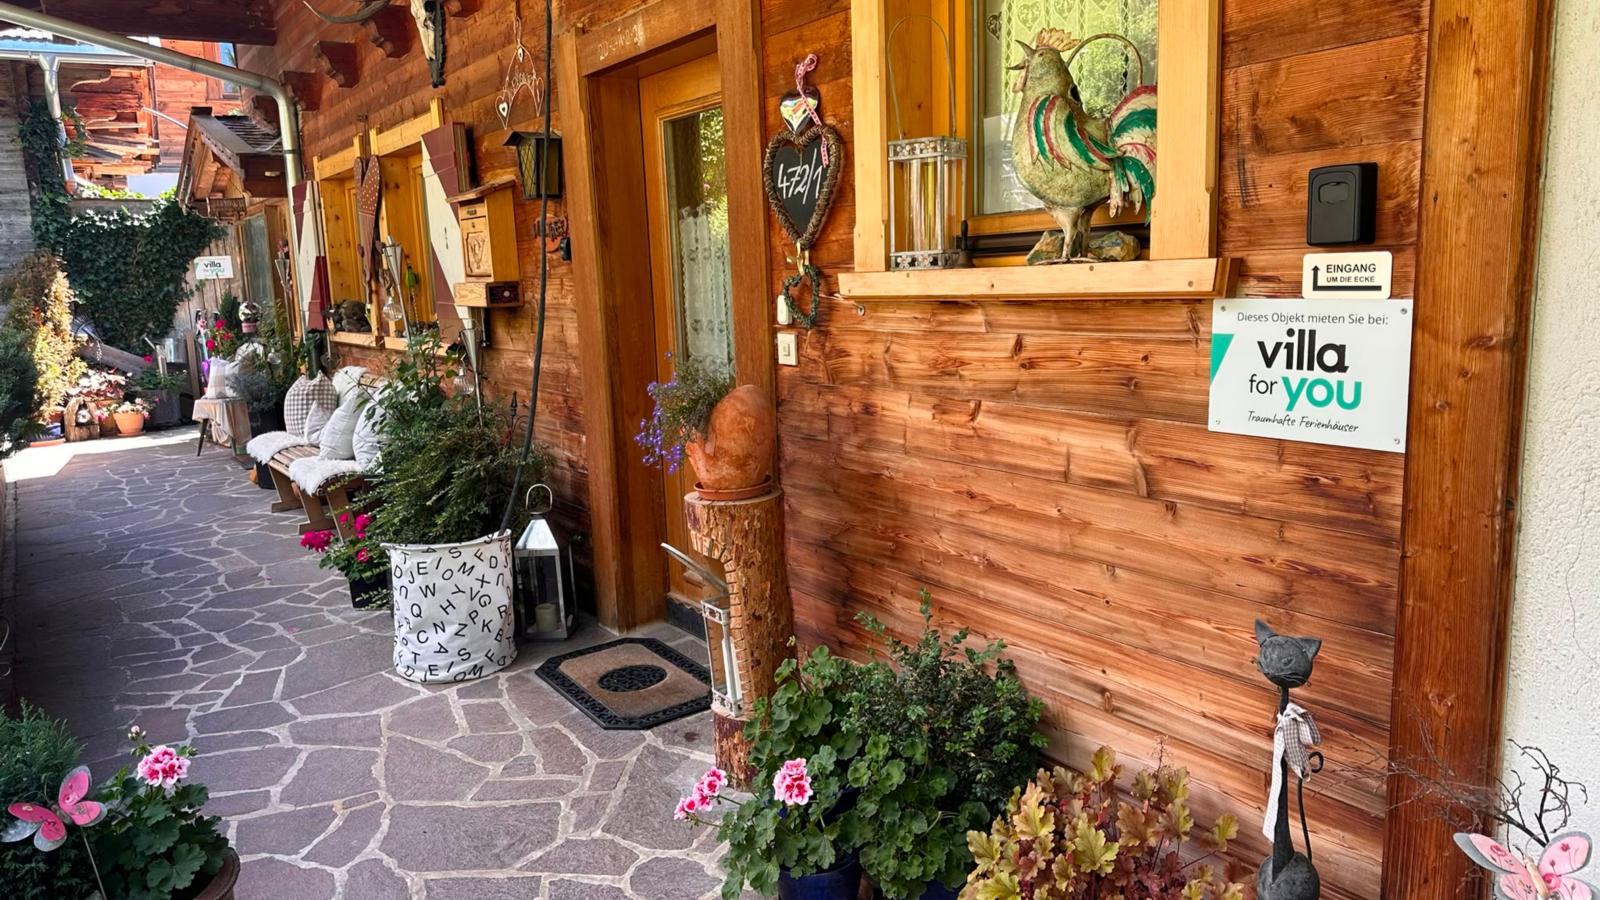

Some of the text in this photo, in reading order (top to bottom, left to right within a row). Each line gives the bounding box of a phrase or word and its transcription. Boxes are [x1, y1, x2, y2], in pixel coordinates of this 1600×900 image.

[777, 148, 823, 206] 472/1
[204, 260, 222, 268] villa
[1326, 263, 1376, 273] EINGANG
[1237, 312, 1388, 325] Dieses Objekt mieten Sie bei:
[1257, 328, 1349, 373] villa
[1249, 374, 1362, 412] for you
[1247, 411, 1359, 433] Traumhafte Ferienhäuser
[449, 547, 461, 559] S
[417, 561, 428, 575] E
[458, 562, 475, 576] M
[489, 556, 498, 568] D
[408, 571, 415, 584] J
[442, 569, 453, 580] O
[475, 574, 490, 588] X
[419, 583, 436, 598] W
[470, 587, 480, 601] V
[440, 599, 456, 615] H
[479, 594, 491, 608] G
[411, 603, 422, 618] Q
[469, 610, 479, 624] P
[433, 621, 446, 634] N
[455, 623, 468, 637] Z
[481, 619, 493, 633] K
[417, 630, 429, 644] C
[434, 642, 449, 654] A
[458, 648, 471, 661] S
[412, 651, 420, 664] T
[428, 664, 439, 676] E
[468, 664, 483, 678] M
